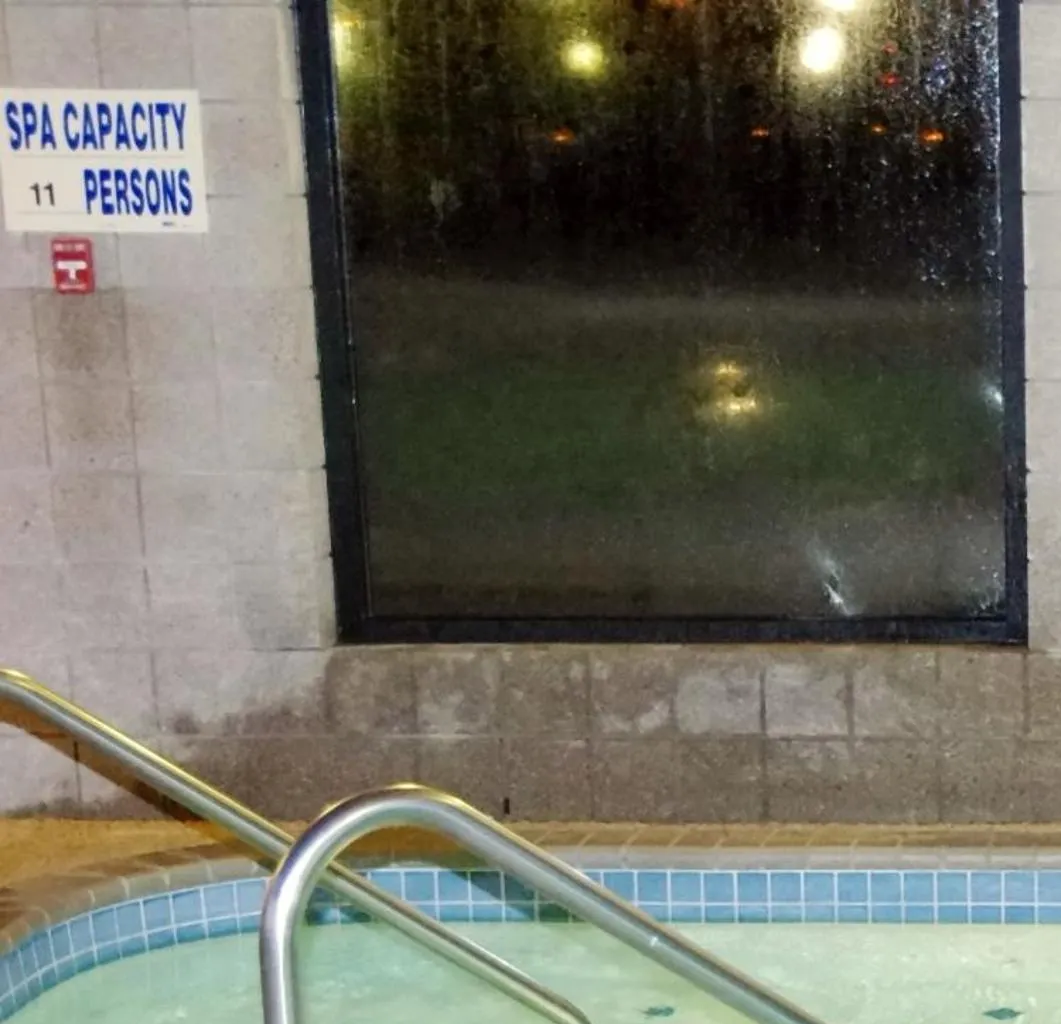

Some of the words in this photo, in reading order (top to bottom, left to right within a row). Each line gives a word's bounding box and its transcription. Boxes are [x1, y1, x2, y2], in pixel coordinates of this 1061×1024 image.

[6, 101, 56, 150] SPA
[63, 101, 187, 150] CAPACITY
[29, 181, 56, 207] 11
[83, 167, 193, 216] PERSONS
